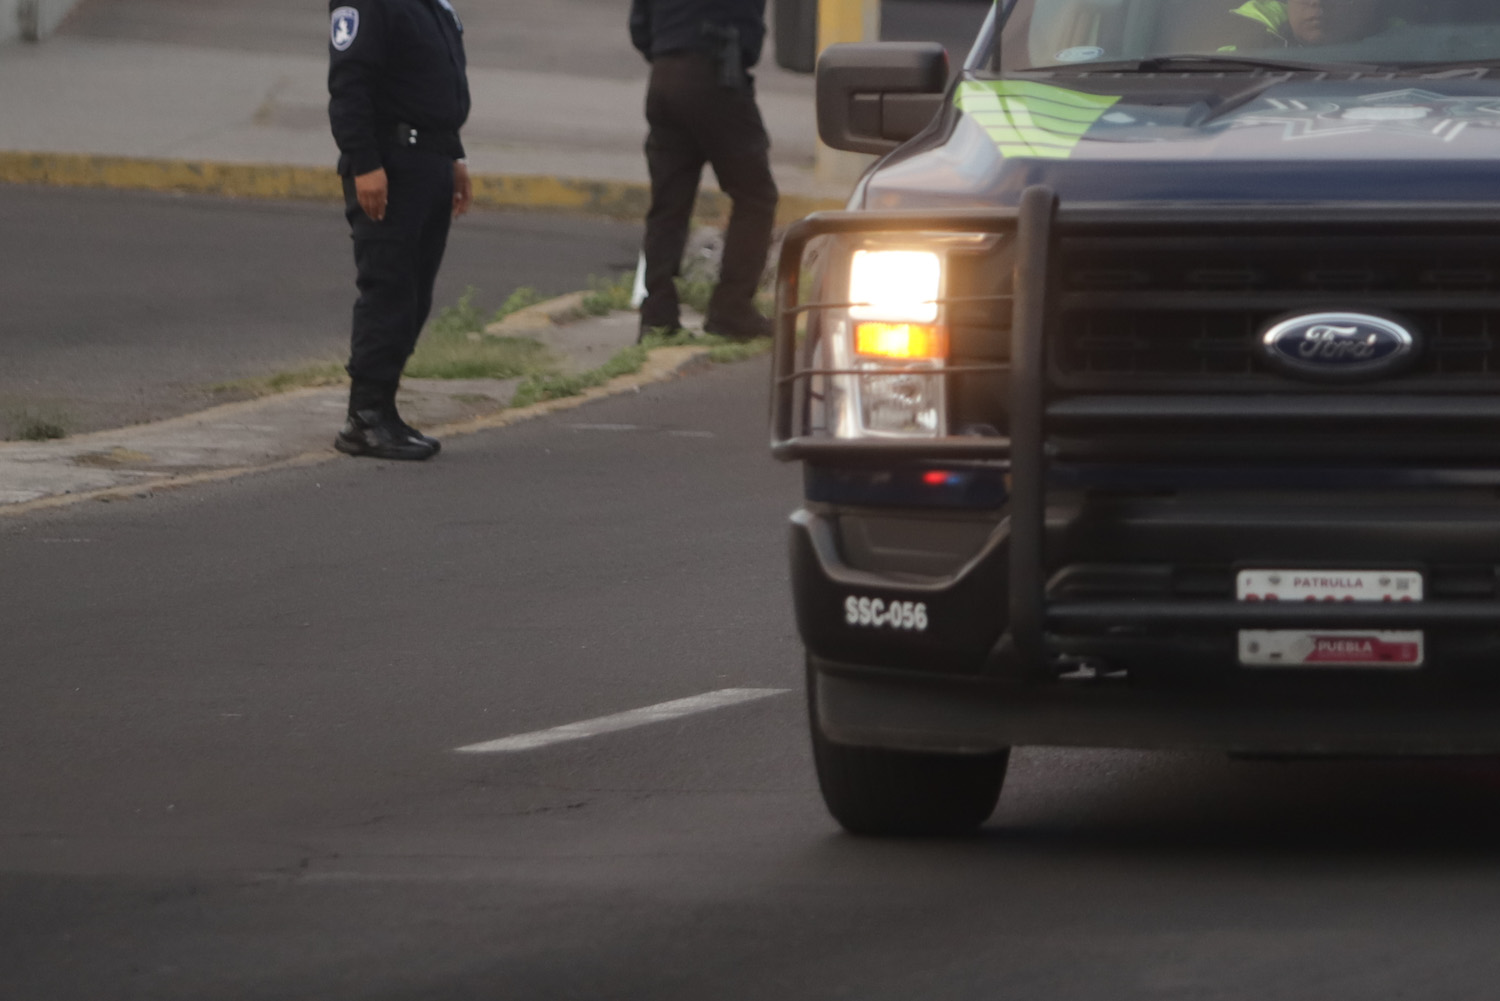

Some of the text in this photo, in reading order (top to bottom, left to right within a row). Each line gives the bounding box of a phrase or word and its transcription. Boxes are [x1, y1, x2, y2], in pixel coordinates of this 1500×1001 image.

[1298, 324, 1377, 358] Ford
[1293, 577, 1364, 589] PATRULLA
[845, 595, 928, 630] SSC-056
[1317, 640, 1373, 653] PUEBLA
